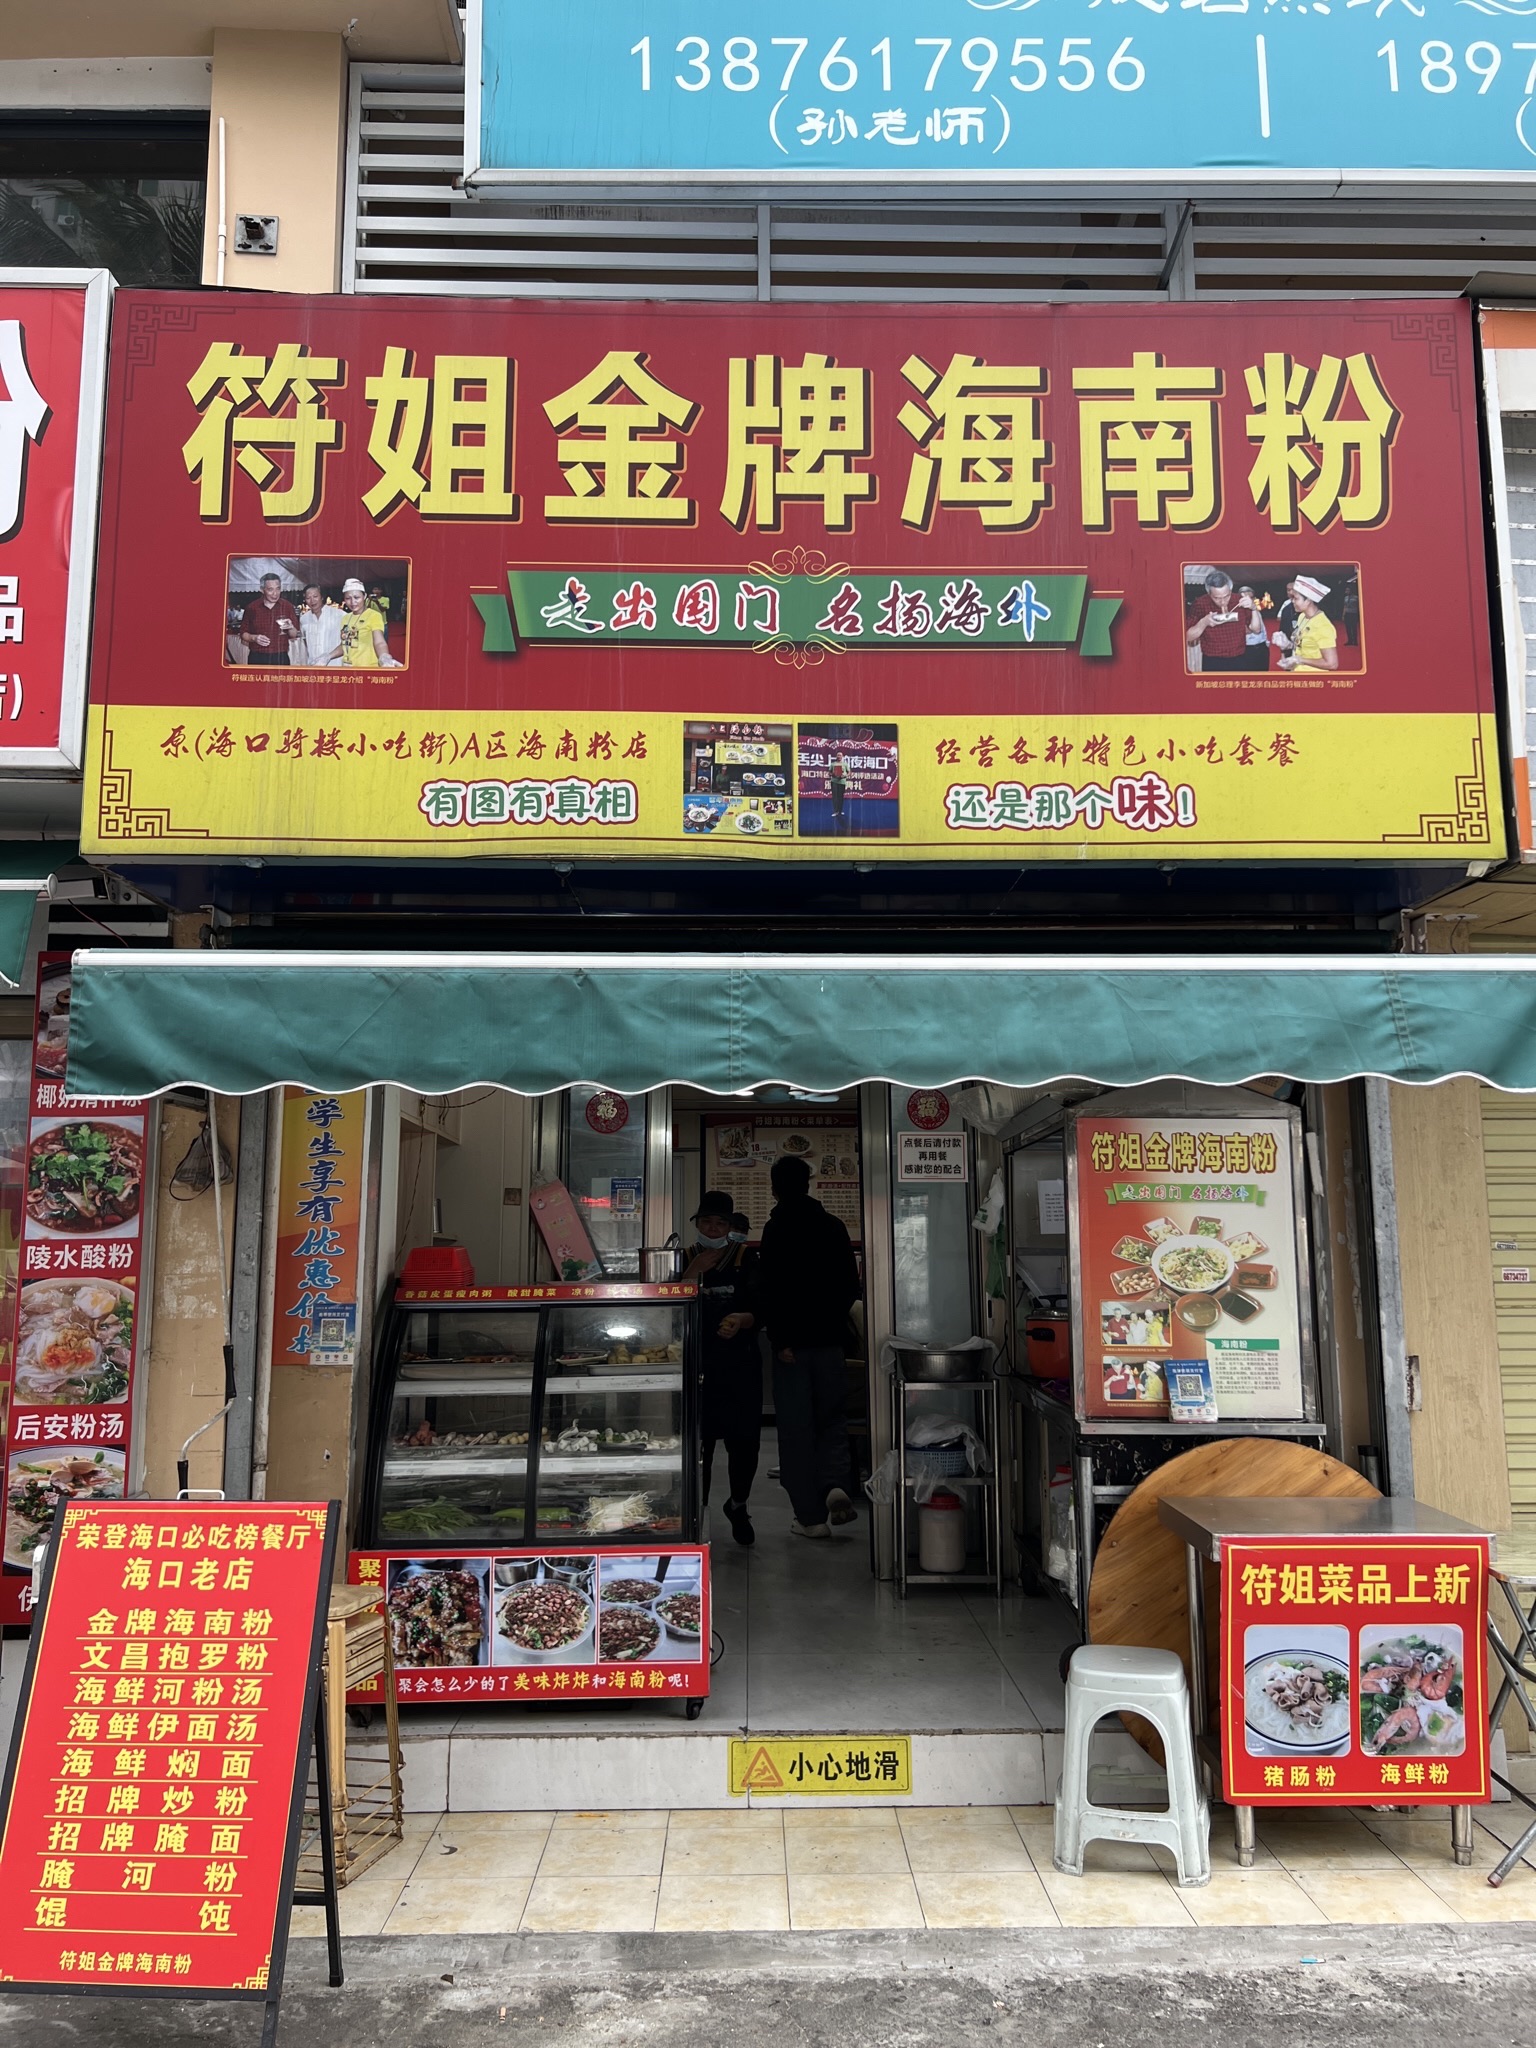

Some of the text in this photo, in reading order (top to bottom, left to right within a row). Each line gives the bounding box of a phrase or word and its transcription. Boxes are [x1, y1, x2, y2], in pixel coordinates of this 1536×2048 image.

[629, 37, 1146, 93] 13876179556
[768, 95, 1012, 155] (孙老师)
[181, 341, 1400, 531] 符姐金牌海南粉
[540, 576, 1051, 642] 走出国门 名扬海外
[934, 734, 1301, 768] 经营各种特色小吃套餐
[420, 778, 638, 826] 有图有真相
[903, 1137, 962, 1149] 点餐后请付款
[918, 1151, 947, 1161] 再用餐
[1091, 1131, 1278, 1173] 符姐金牌海南粉
[904, 1164, 962, 1175] 感谢您的配合
[26, 1243, 134, 1270] 陵水酸粉
[657, 1285, 695, 1296] 地瓜粉
[14, 1413, 125, 1440] 后安粉汤
[76, 1523, 311, 1550] 荣登海口必吃榜餐厅
[121, 1557, 254, 1591] 海口老店
[1240, 1563, 1471, 1606] 符姐菜品上新
[87, 1608, 274, 1636] 金牌海南粉
[79, 1642, 269, 1671] 文昌抱罗粉
[73, 1676, 263, 1706] 海鲜河粉汤
[67, 1712, 258, 1741] 海鲜伊面汤
[60, 1748, 254, 1779] 海鲜焖面
[789, 1751, 899, 1781] 小心地滑
[1264, 1763, 1449, 1787] 猪肠粉 海鲜粉
[54, 1784, 248, 1816] 招牌炒粉
[48, 1821, 243, 1853] 招牌腌面
[59, 1950, 193, 1975] 符姐金牌海南粉
